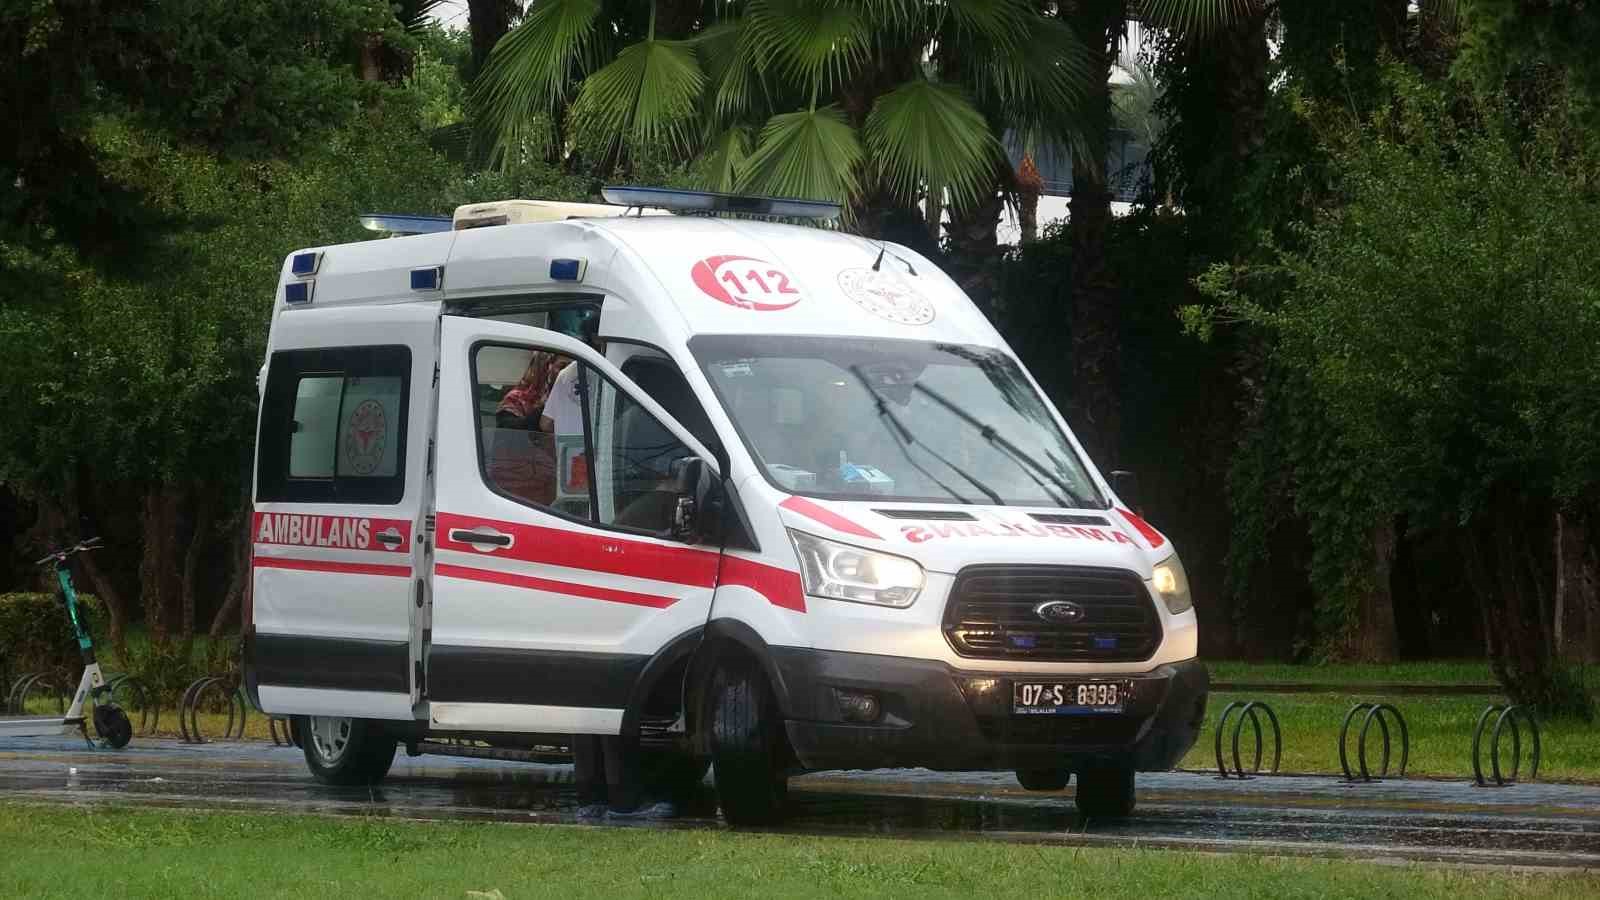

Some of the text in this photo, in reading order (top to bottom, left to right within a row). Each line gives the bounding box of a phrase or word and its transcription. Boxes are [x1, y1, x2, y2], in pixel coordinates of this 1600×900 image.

[721, 270, 799, 294] 112
[258, 513, 371, 549] AMBULANS
[1022, 684, 1042, 706] 07
[1053, 684, 1063, 706] S
